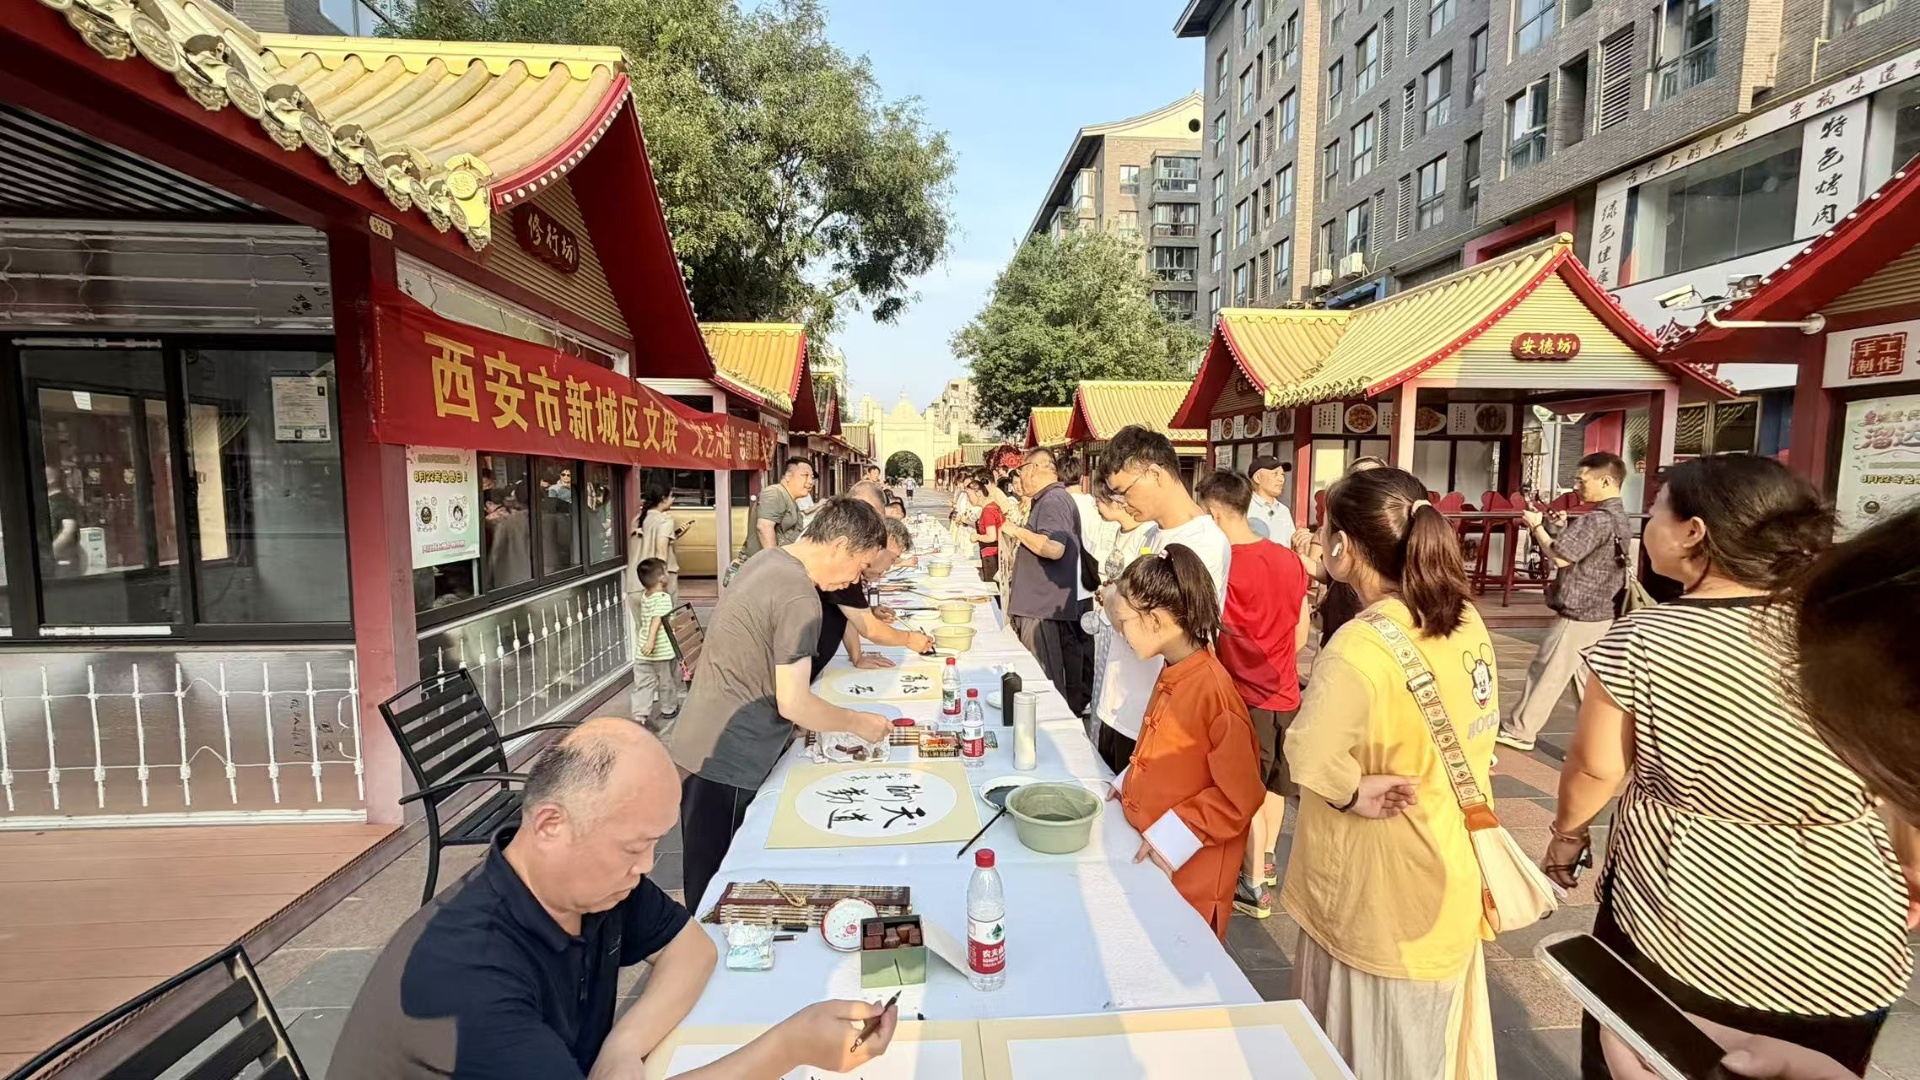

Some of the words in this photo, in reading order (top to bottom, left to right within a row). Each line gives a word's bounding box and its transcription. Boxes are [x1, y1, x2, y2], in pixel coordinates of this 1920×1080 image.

[1811, 114, 1848, 226] 特色烤肉
[528, 213, 573, 264] 修行坊
[1519, 336, 1572, 355] 安德坊
[1857, 340, 1899, 357] 手工
[1855, 356, 1898, 373] 制作
